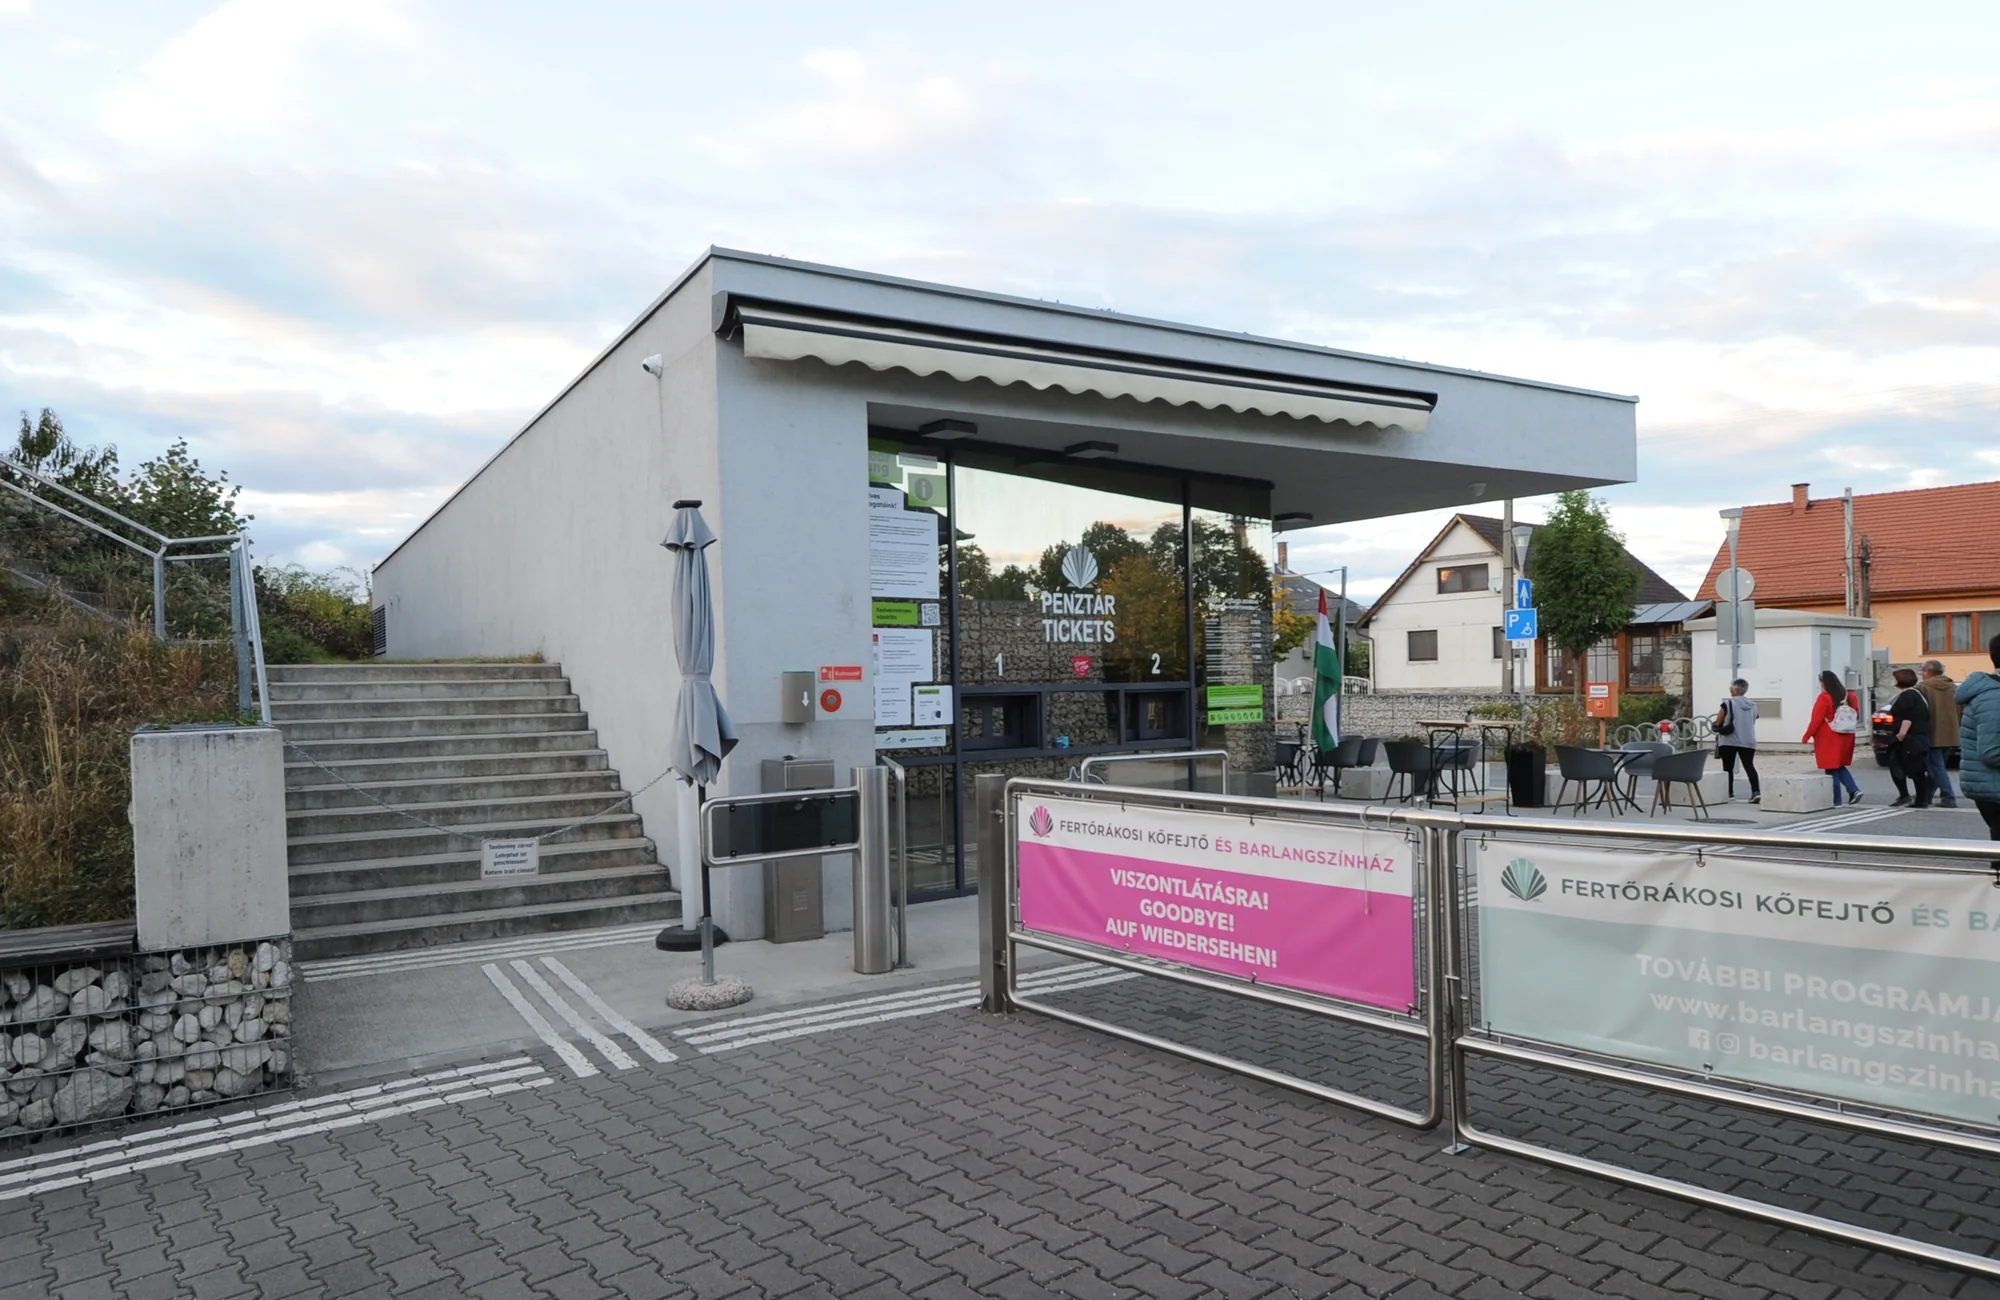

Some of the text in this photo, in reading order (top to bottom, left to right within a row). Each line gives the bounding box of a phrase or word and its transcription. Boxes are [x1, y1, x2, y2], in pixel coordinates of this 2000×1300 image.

[1042, 586, 1116, 615] PÉNZTÁR
[1042, 619, 1115, 643] TICKETS
[1509, 614, 1520, 628] P
[995, 653, 1003, 676] 1
[1151, 653, 1160, 675] 2
[1060, 820, 1394, 873] FERTŐRÁKOSI KŐFEJTŐ ÉS BARLANGSZÍNHÁZ
[1110, 868, 1269, 911] VISZONTLÁTÁSRA!
[1561, 878, 1743, 910] FERTŐRÁKOSI
[1756, 892, 1895, 925] KŐFEJTŐ
[1911, 903, 1951, 929] ÉS
[1140, 899, 1235, 932] GOODBYE!
[1106, 918, 1278, 969] AUF WIEDERSEHEN!
[1635, 954, 1772, 993] TOVÁBBI
